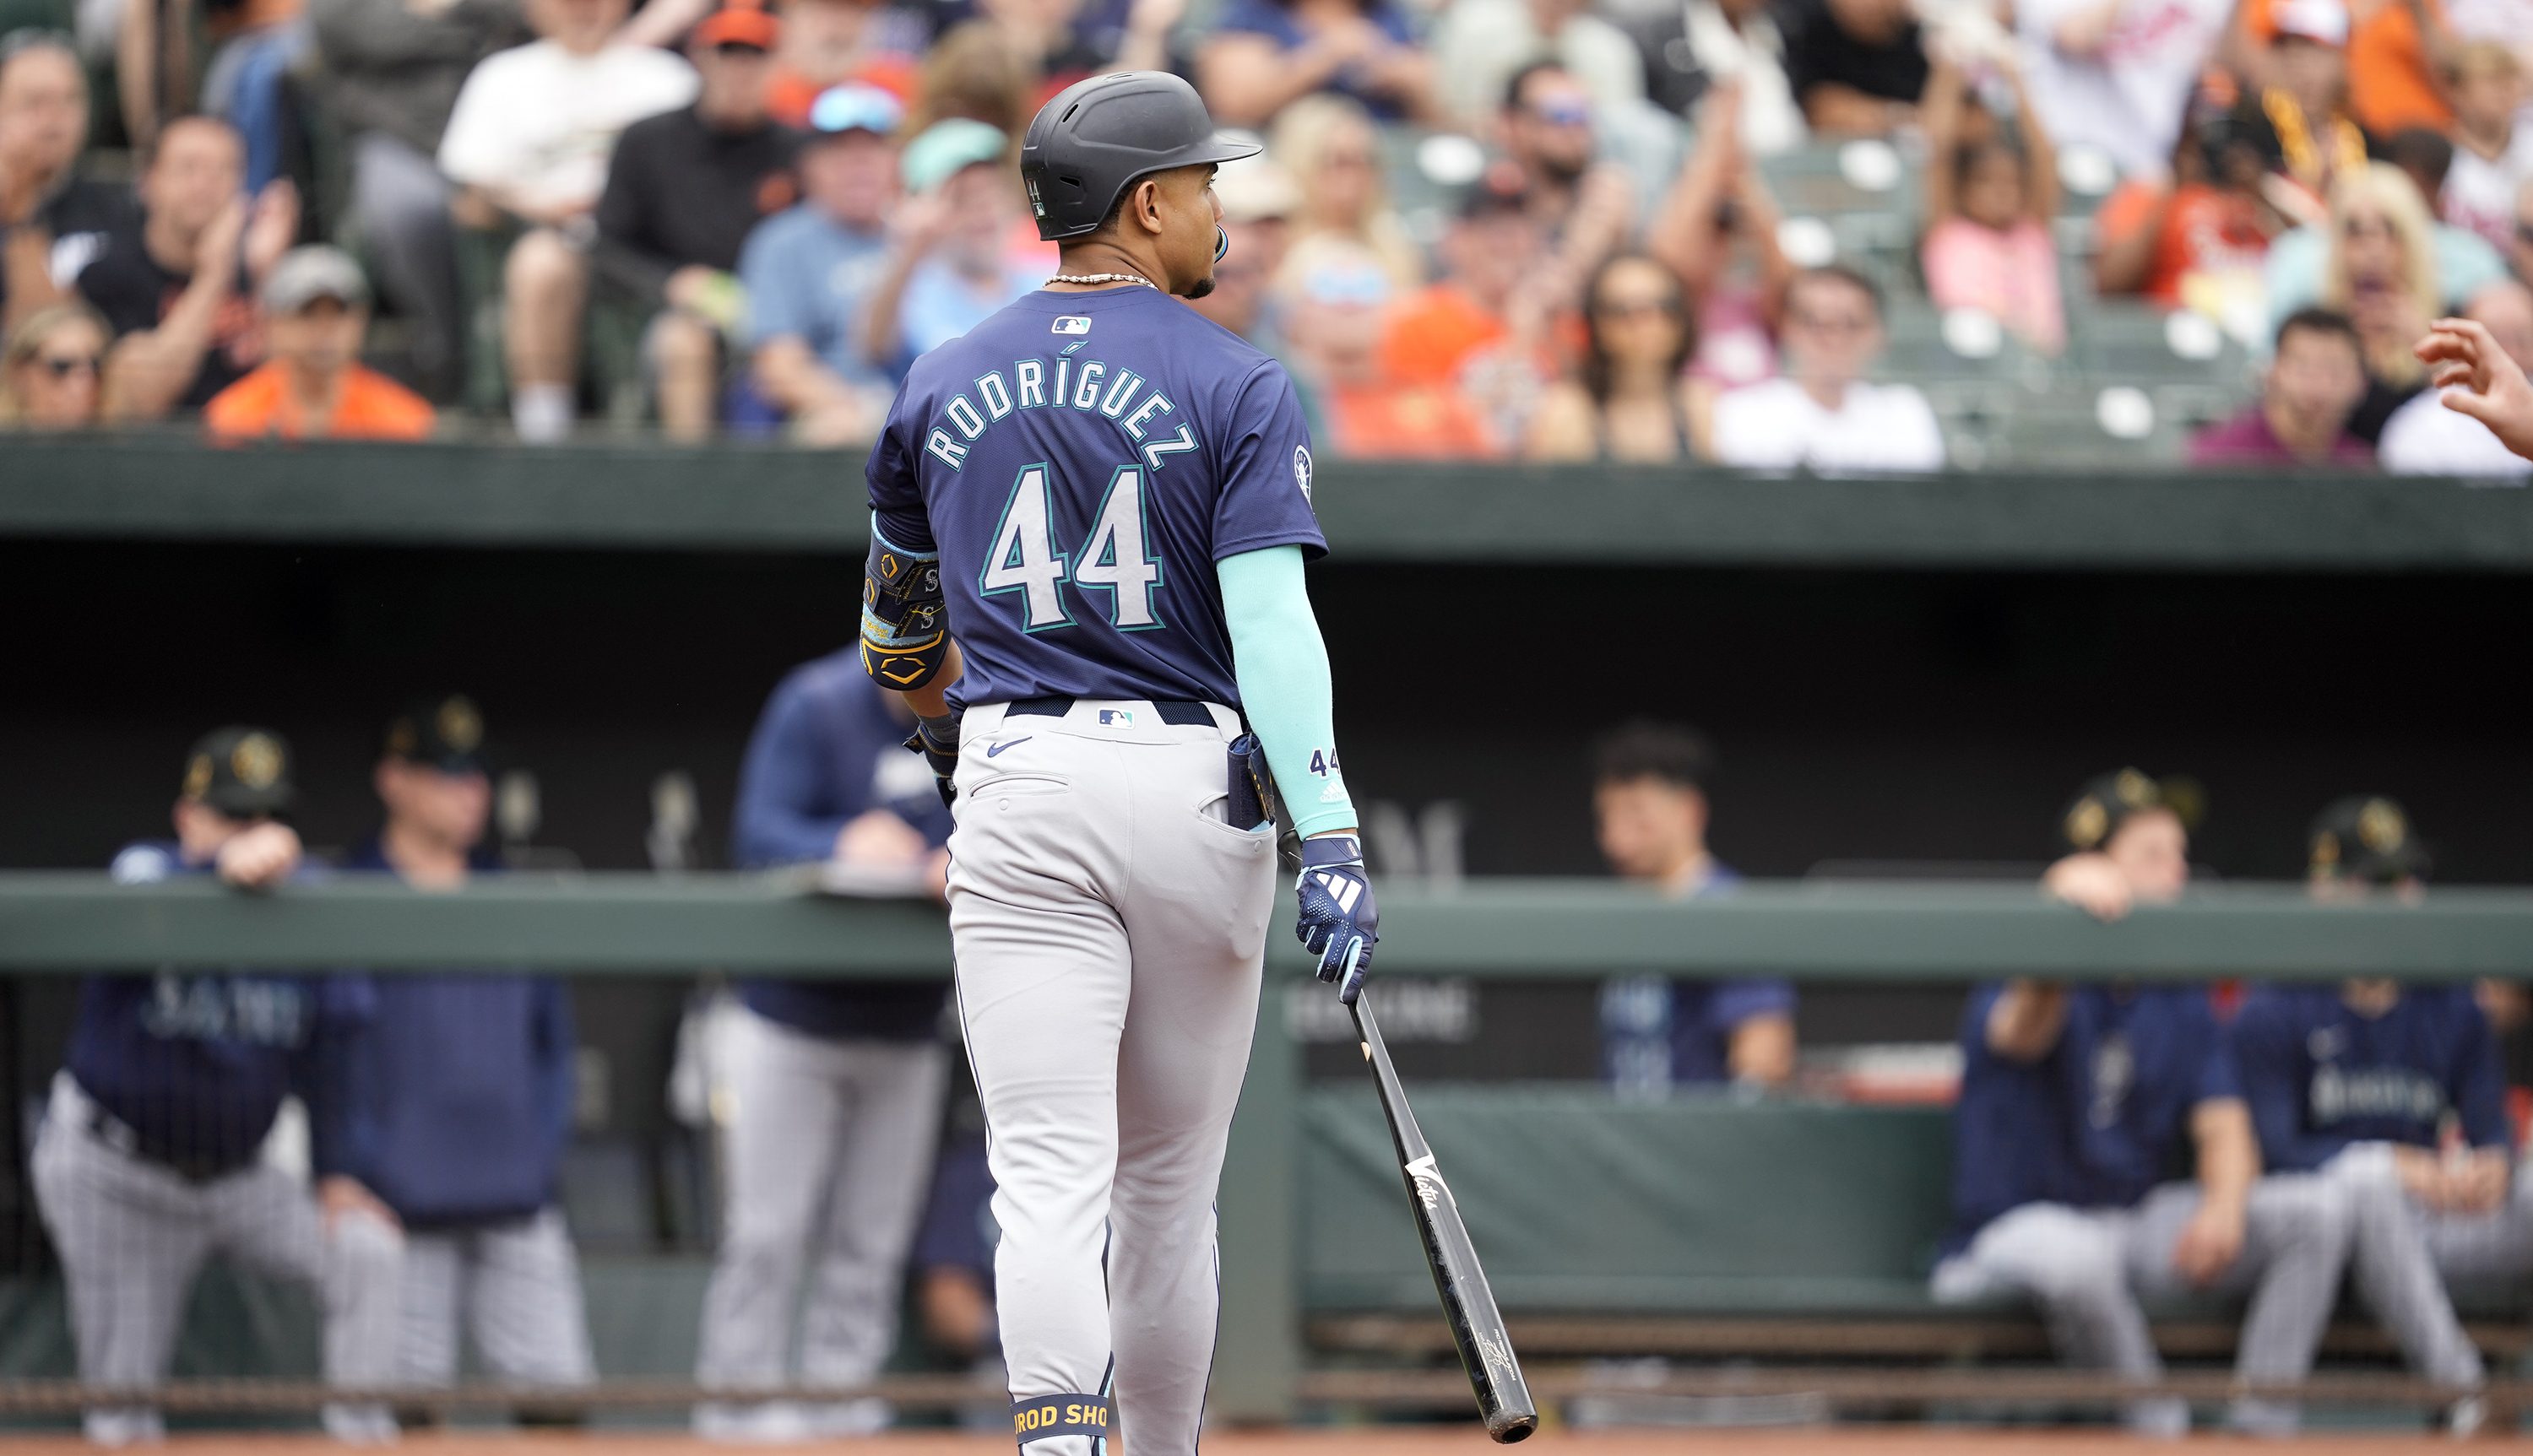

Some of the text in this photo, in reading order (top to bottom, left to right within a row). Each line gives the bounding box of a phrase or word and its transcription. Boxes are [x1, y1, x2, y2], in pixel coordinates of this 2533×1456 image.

[925, 341, 1199, 473] RODRÍGUEZ
[979, 462, 1166, 634] 44
[1309, 747, 1341, 777] 44
[1404, 1153, 1456, 1210] Victus
